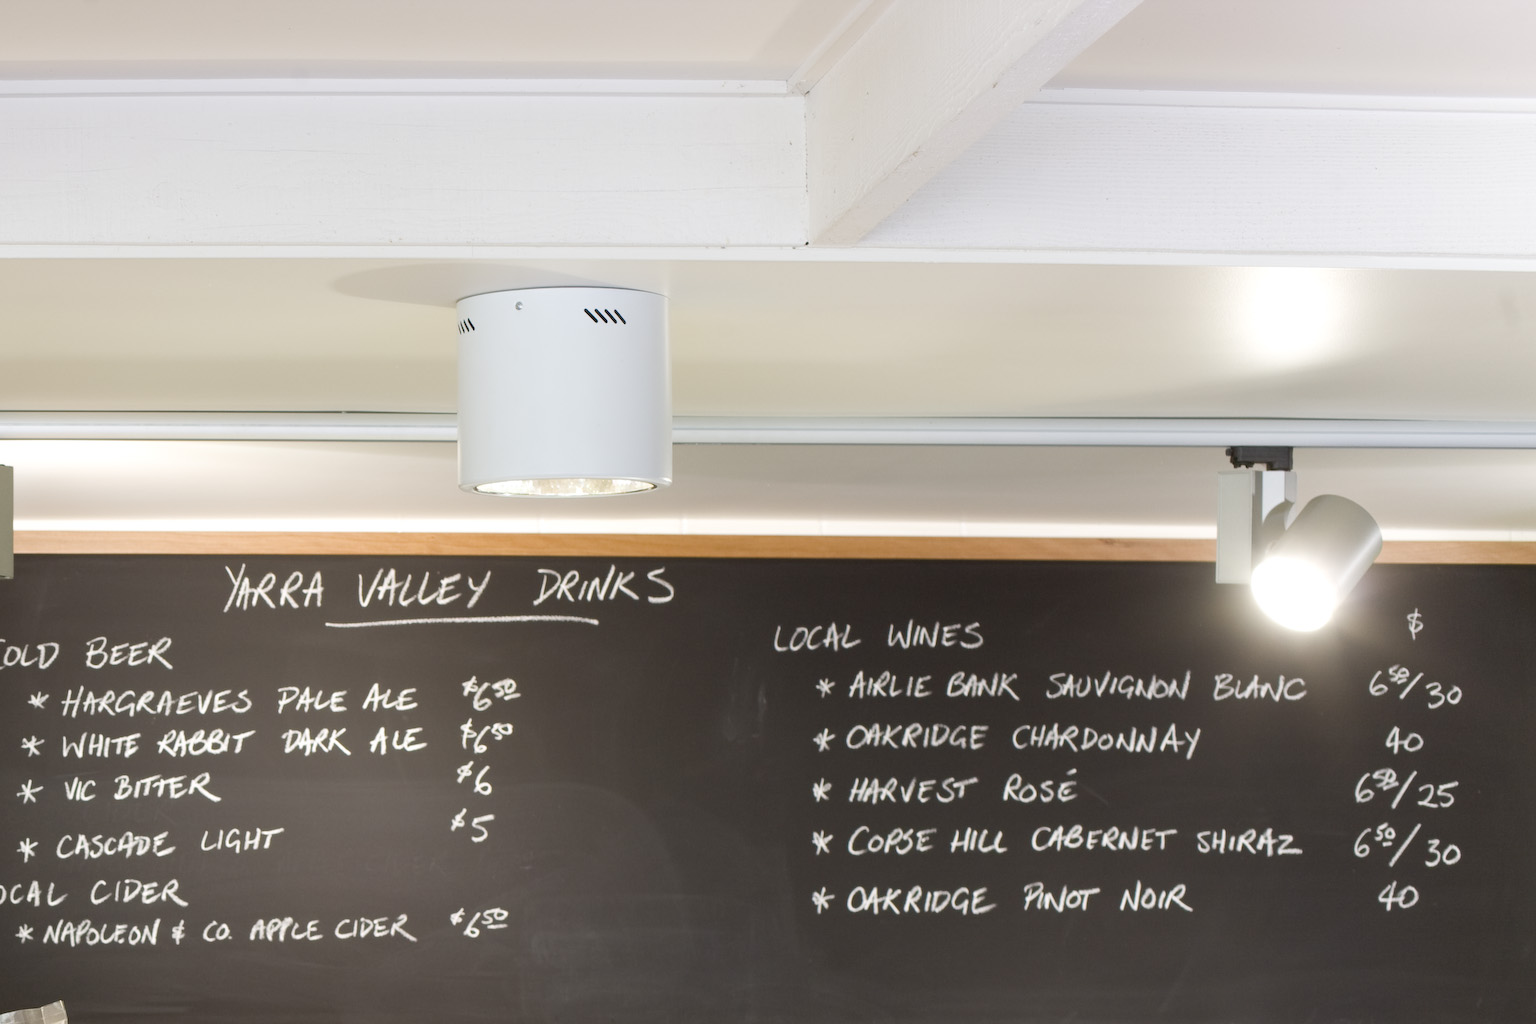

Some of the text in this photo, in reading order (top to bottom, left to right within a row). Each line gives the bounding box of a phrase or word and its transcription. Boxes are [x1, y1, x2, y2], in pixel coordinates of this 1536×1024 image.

[223, 562, 675, 613] YARRA VALLEY DRINKS
[773, 618, 984, 653] LOCAL WINES
[1406, 607, 1424, 641] $
[85, 636, 174, 670] BEER
[60, 685, 253, 719] HARGRAEVES
[277, 686, 348, 715] PALE
[361, 683, 419, 713] ALE
[848, 670, 1307, 702] AIRLIE BANK SAUVIGNON BLANC
[62, 731, 142, 759] WHITE
[156, 728, 256, 757] RABBIT
[281, 727, 352, 757] DARK
[369, 726, 428, 755] ALE
[845, 722, 1202, 761] OAKRIDGE CHARDONNAY
[1385, 725, 1425, 755] 40
[64, 771, 222, 803] VIC BITTER
[848, 776, 979, 805] HARVEST
[55, 827, 285, 860] CASCADE LIGHT
[847, 824, 1304, 858] COPSE HILL CABERNET SHIRAZ
[90, 878, 189, 908] CIDER
[846, 879, 1194, 916] OAKRIDGE PINOT NOIR
[1377, 880, 1420, 912] 40
[42, 917, 162, 948] NAPOLEON
[249, 916, 324, 943] APPLE
[334, 913, 418, 943] CIDER
